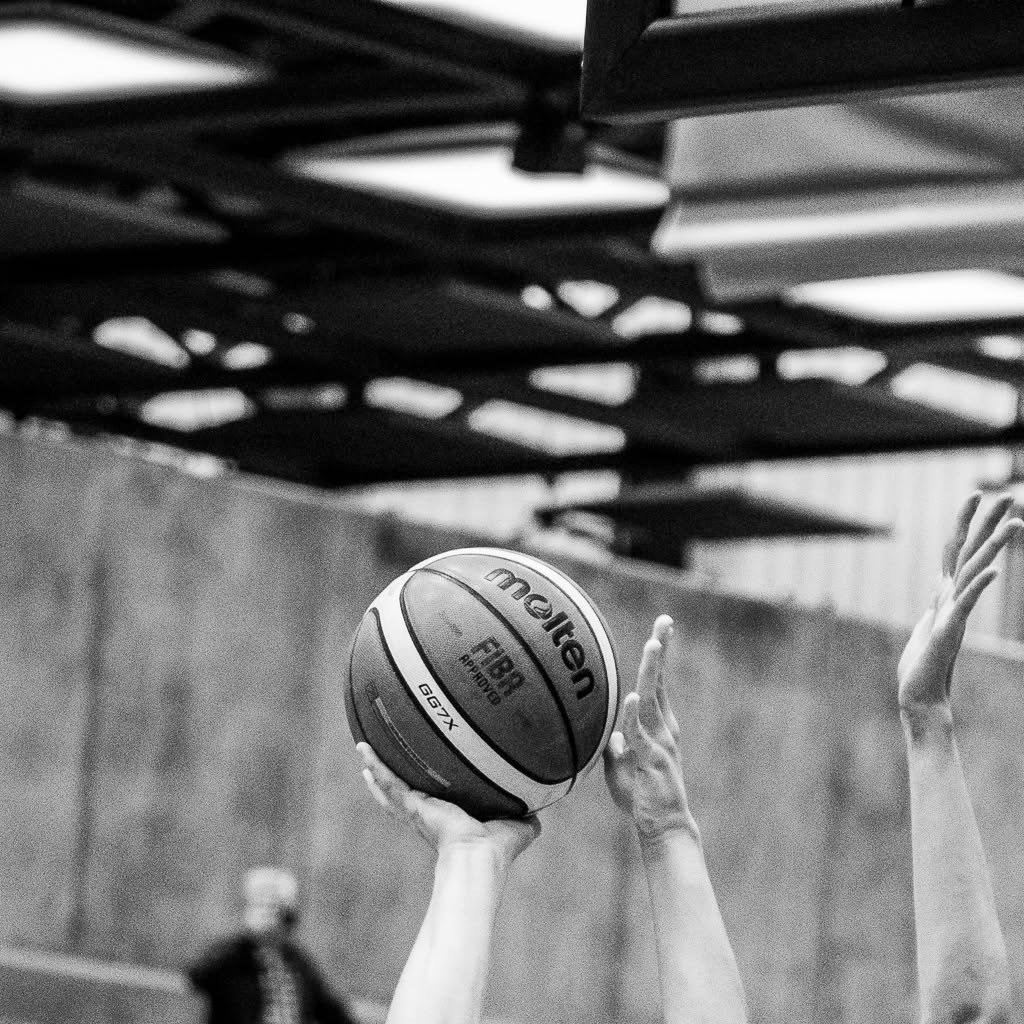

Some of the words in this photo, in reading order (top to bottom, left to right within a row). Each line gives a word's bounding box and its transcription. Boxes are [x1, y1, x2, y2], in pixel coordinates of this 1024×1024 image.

[484, 568, 595, 700] molten
[459, 654, 502, 706] APPROVED
[418, 683, 460, 731] GG7X
